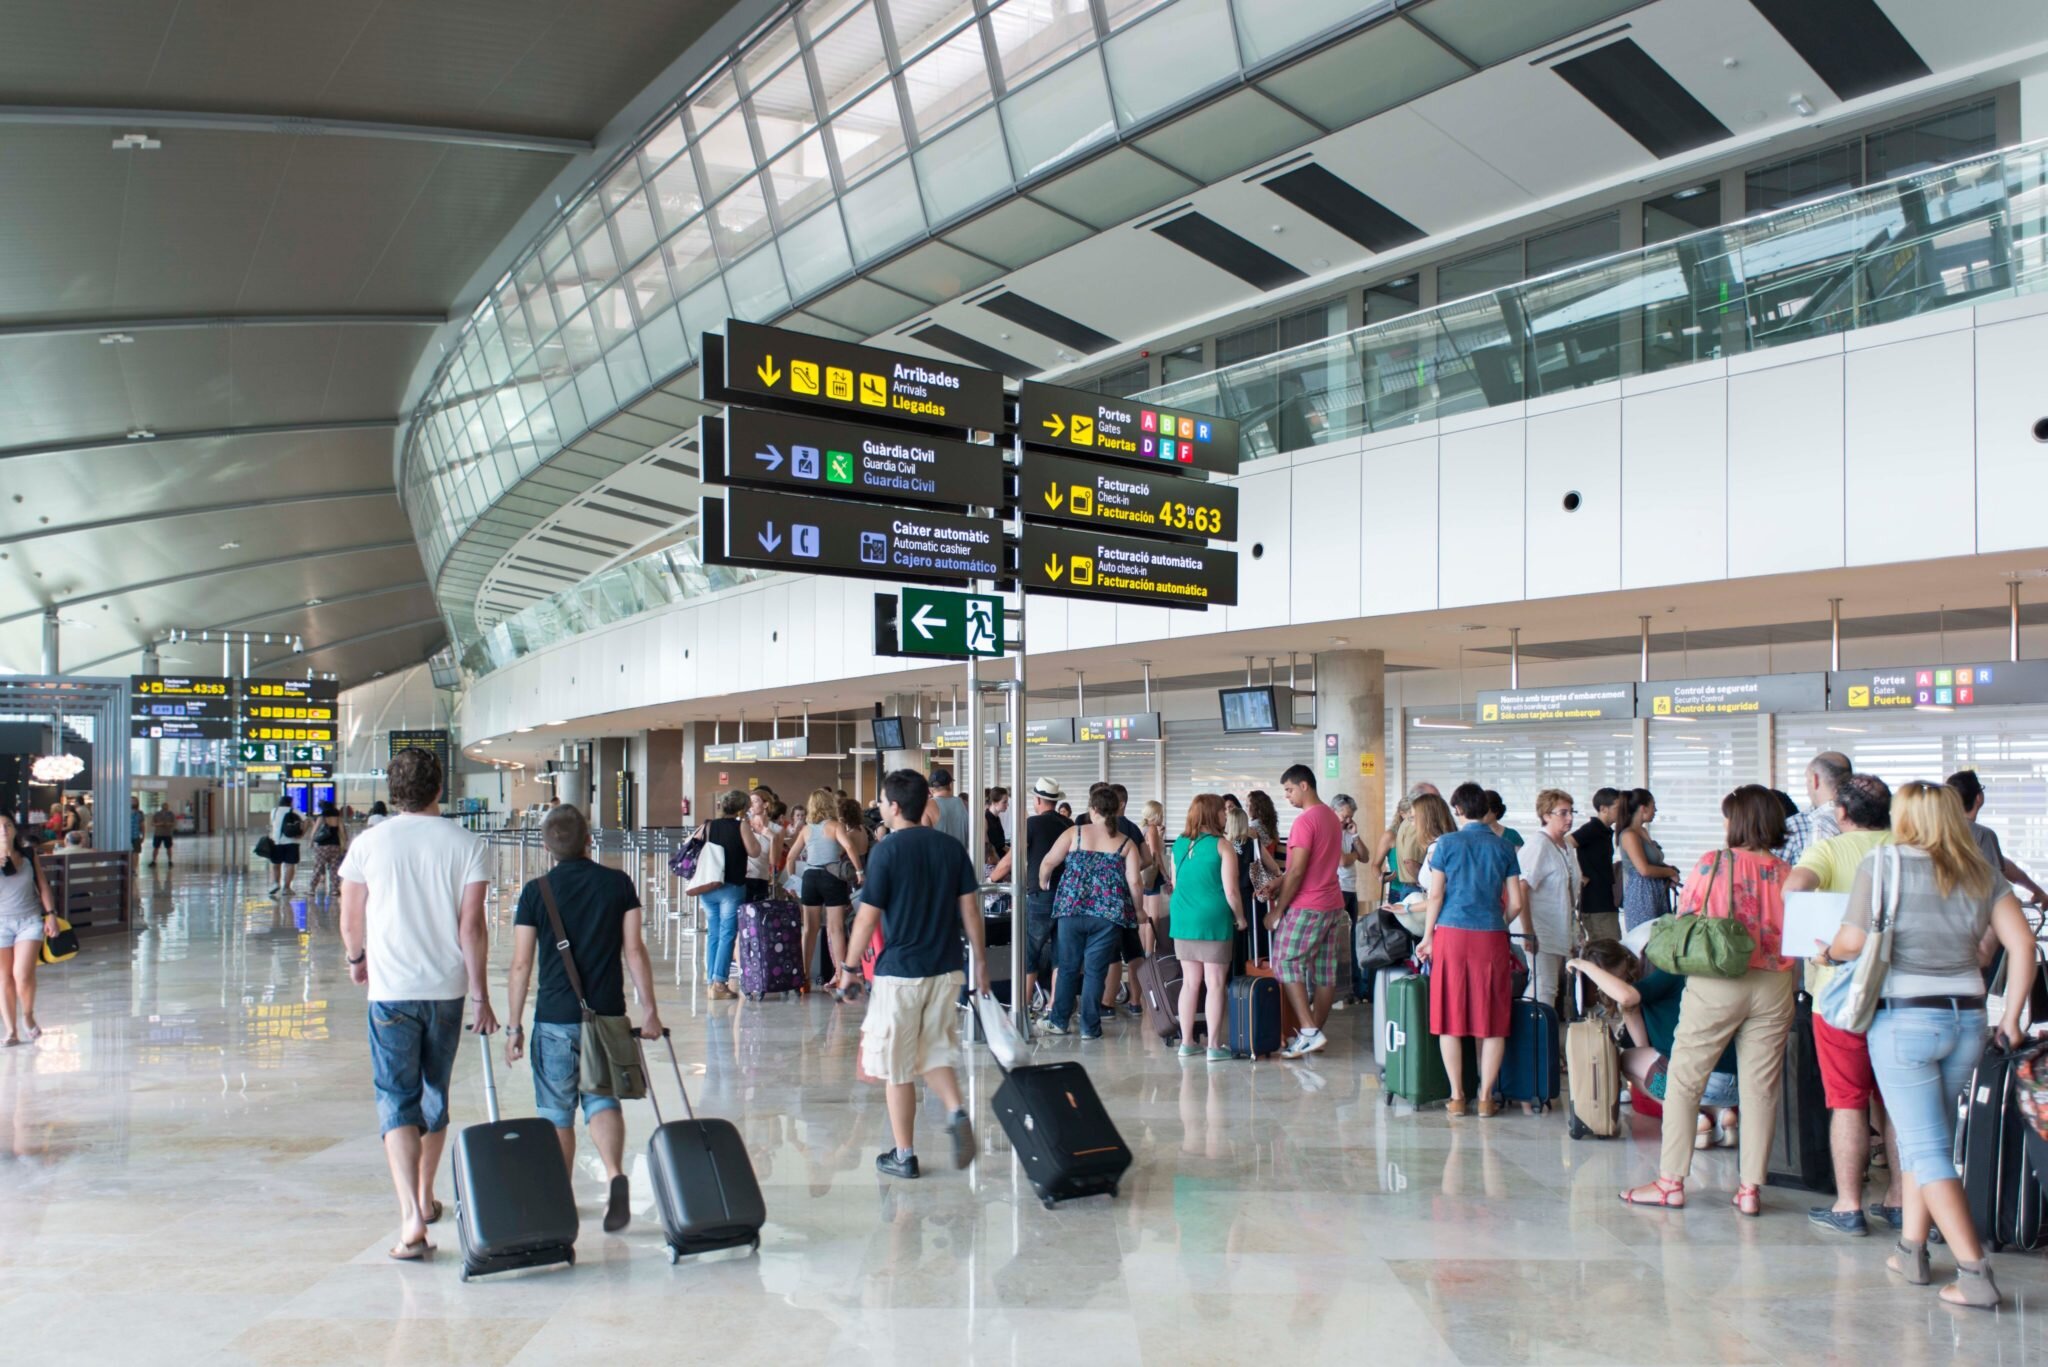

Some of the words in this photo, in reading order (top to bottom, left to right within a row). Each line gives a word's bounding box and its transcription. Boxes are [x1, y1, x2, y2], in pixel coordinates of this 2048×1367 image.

[893, 363, 960, 389] Arribades
[893, 380, 928, 398] Arrivals
[893, 395, 946, 417] Llegadas
[1098, 406, 1132, 424] Portes
[1144, 414, 1154, 429] A
[1163, 418, 1172, 432] B
[1181, 422, 1190, 435] C
[1199, 424, 1209, 439] R
[1098, 421, 1121, 435] Gates
[863, 440, 909, 461] Guàrdia
[910, 446, 935, 464] Civil
[1098, 434, 1137, 453] Puertas
[1144, 439, 1153, 453] D
[1162, 442, 1171, 456] E
[1181, 446, 1189, 459] F
[863, 457, 897, 472] Guardia
[897, 459, 916, 475] Civil
[863, 471, 910, 491] Guardia
[910, 477, 935, 493] Civil
[1098, 476, 1150, 496] Facturació
[1097, 491, 1130, 506] Check-in
[1097, 504, 1155, 524] Facturación
[1159, 501, 1187, 529] 43
[1187, 505, 1195, 516] to
[1194, 507, 1222, 534] 63
[893, 520, 932, 539] Caixer
[933, 525, 990, 544] automàtic
[893, 537, 939, 553] Automatic
[940, 542, 971, 556] cashier
[893, 552, 933, 570] Cajero
[934, 555, 997, 574] automático
[1098, 546, 1150, 564] Facturació
[1151, 553, 1203, 570] automàtica
[1098, 561, 1116, 574] Auto
[1117, 562, 1148, 576] check-in
[1097, 573, 1155, 592] Facturación
[1156, 580, 1208, 598] automática
[1873, 675, 1906, 686] Portes
[1919, 674, 1928, 684] A
[1979, 670, 1989, 681] R
[1525, 693, 1540, 702] amb
[1541, 693, 1567, 703] targeta
[1674, 686, 1704, 696] Control
[1705, 685, 1716, 694] de
[1717, 683, 1758, 695] seguretat
[1873, 686, 1896, 695] Gates
[1873, 695, 1912, 706] Puertas
[1919, 692, 1929, 702] D
[1940, 690, 1948, 701] E
[1960, 689, 1969, 701] F
[1674, 695, 1700, 705] Security
[1700, 694, 1725, 703] Control
[1674, 704, 1704, 714] Control
[1705, 703, 1716, 713] de
[1717, 701, 1760, 713] seguridad
[1529, 710, 1554, 720] tarjeta
[1554, 709, 1564, 718] de
[1564, 708, 1601, 718] embarque
